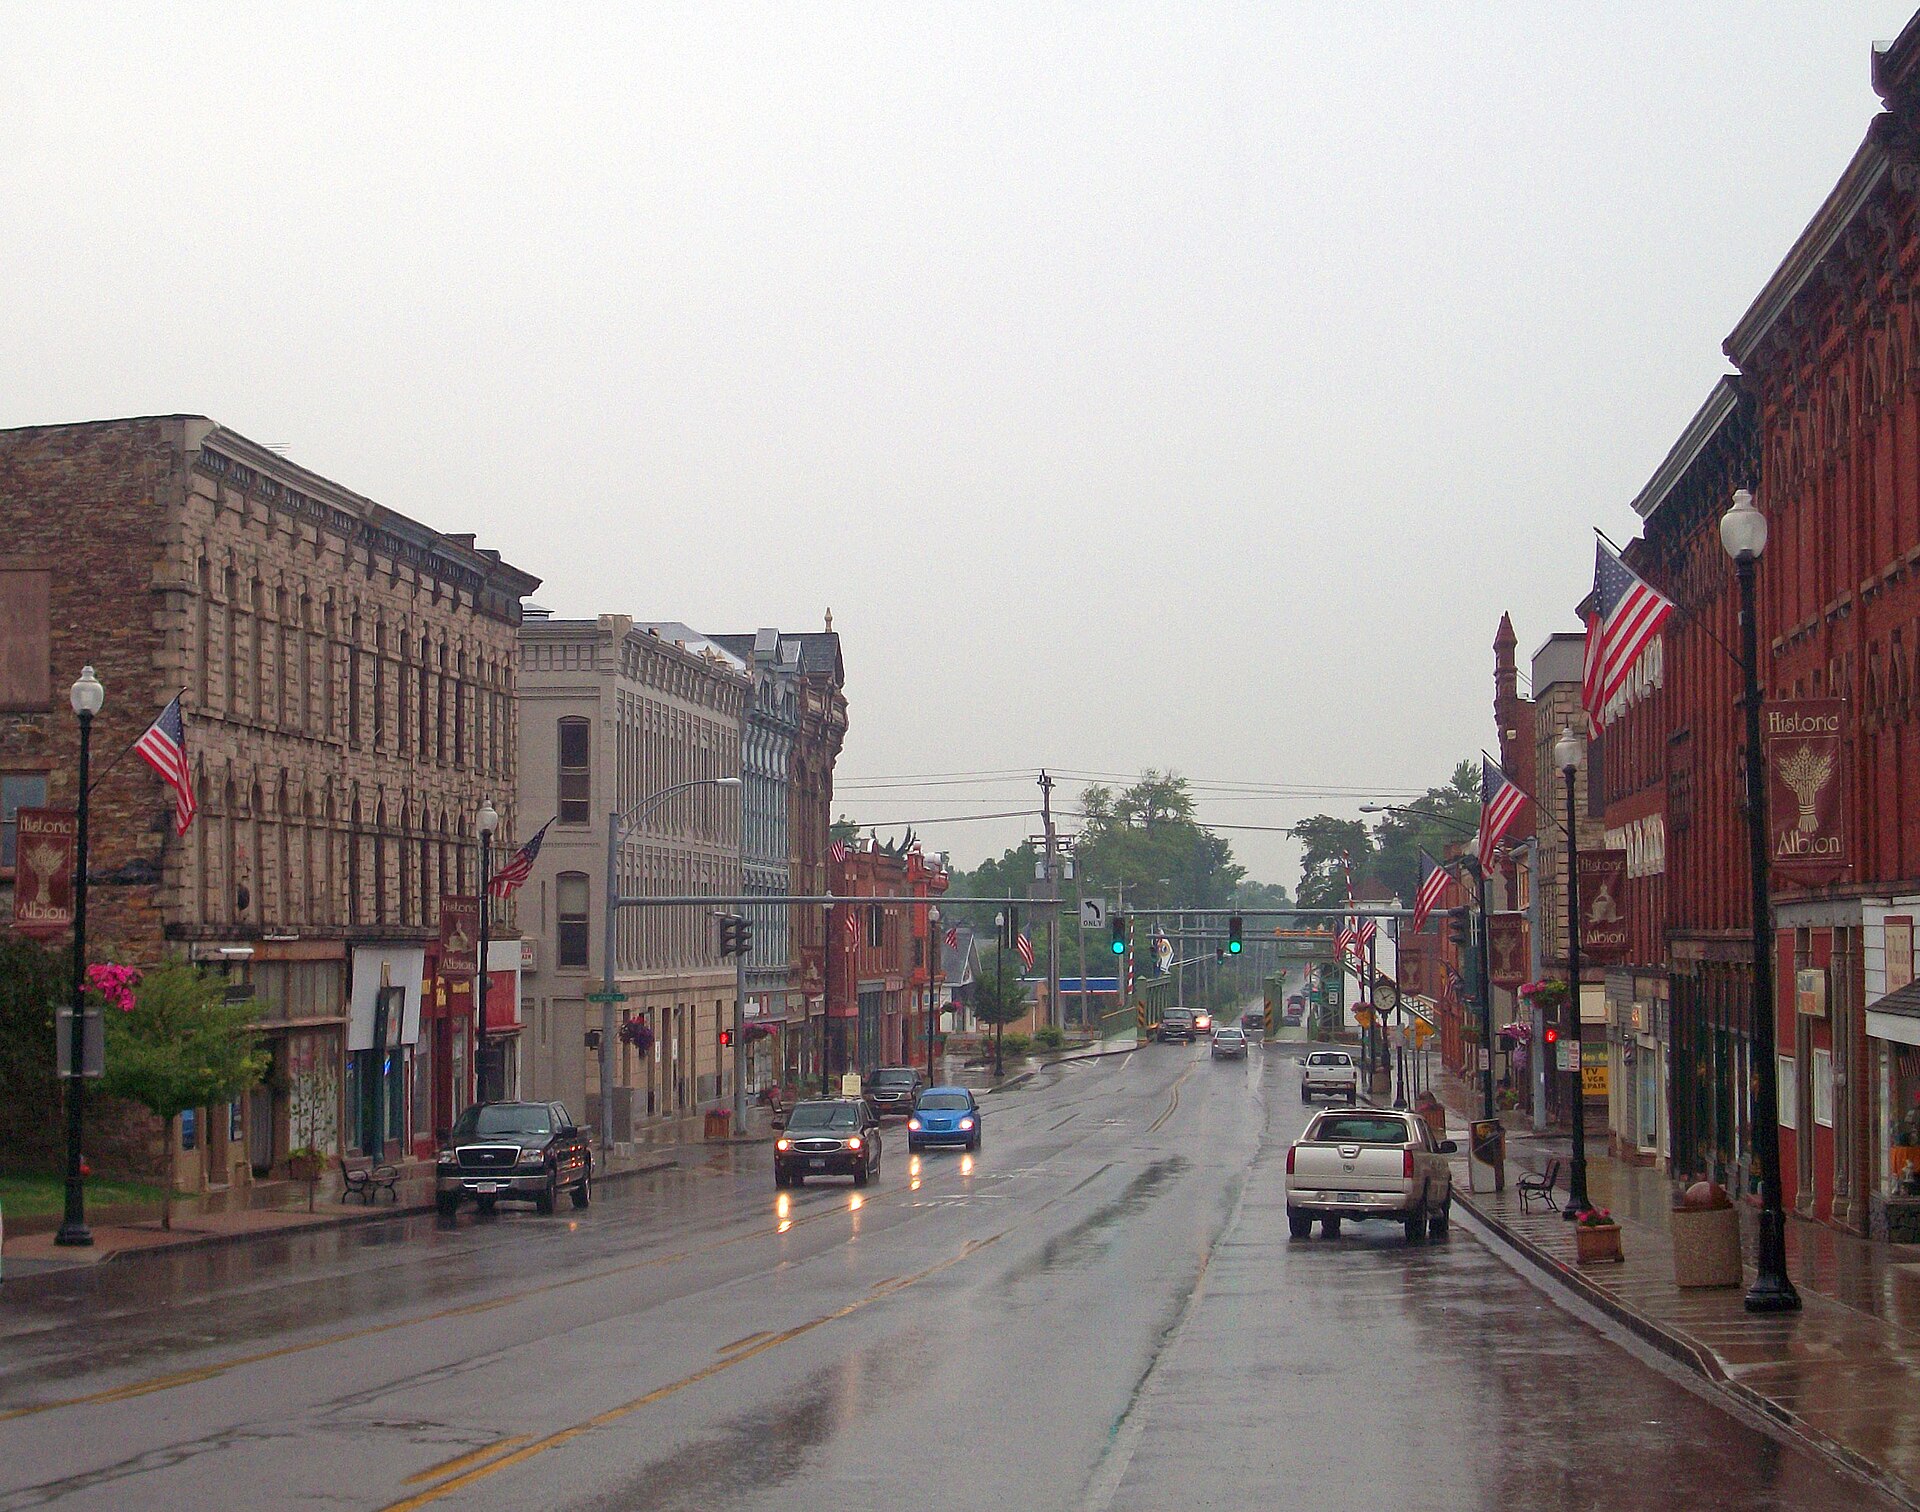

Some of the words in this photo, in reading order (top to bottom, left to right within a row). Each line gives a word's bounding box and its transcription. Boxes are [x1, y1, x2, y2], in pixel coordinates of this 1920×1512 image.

[1768, 711, 1840, 733] Historic
[19, 816, 72, 834] Historic
[1777, 829, 1841, 855] Albion
[1581, 859, 1625, 872] Historic
[19, 901, 68, 920] Albion
[1586, 930, 1626, 944] Albion
[442, 957, 476, 970] Albion
[1584, 1067, 1598, 1075] TV
